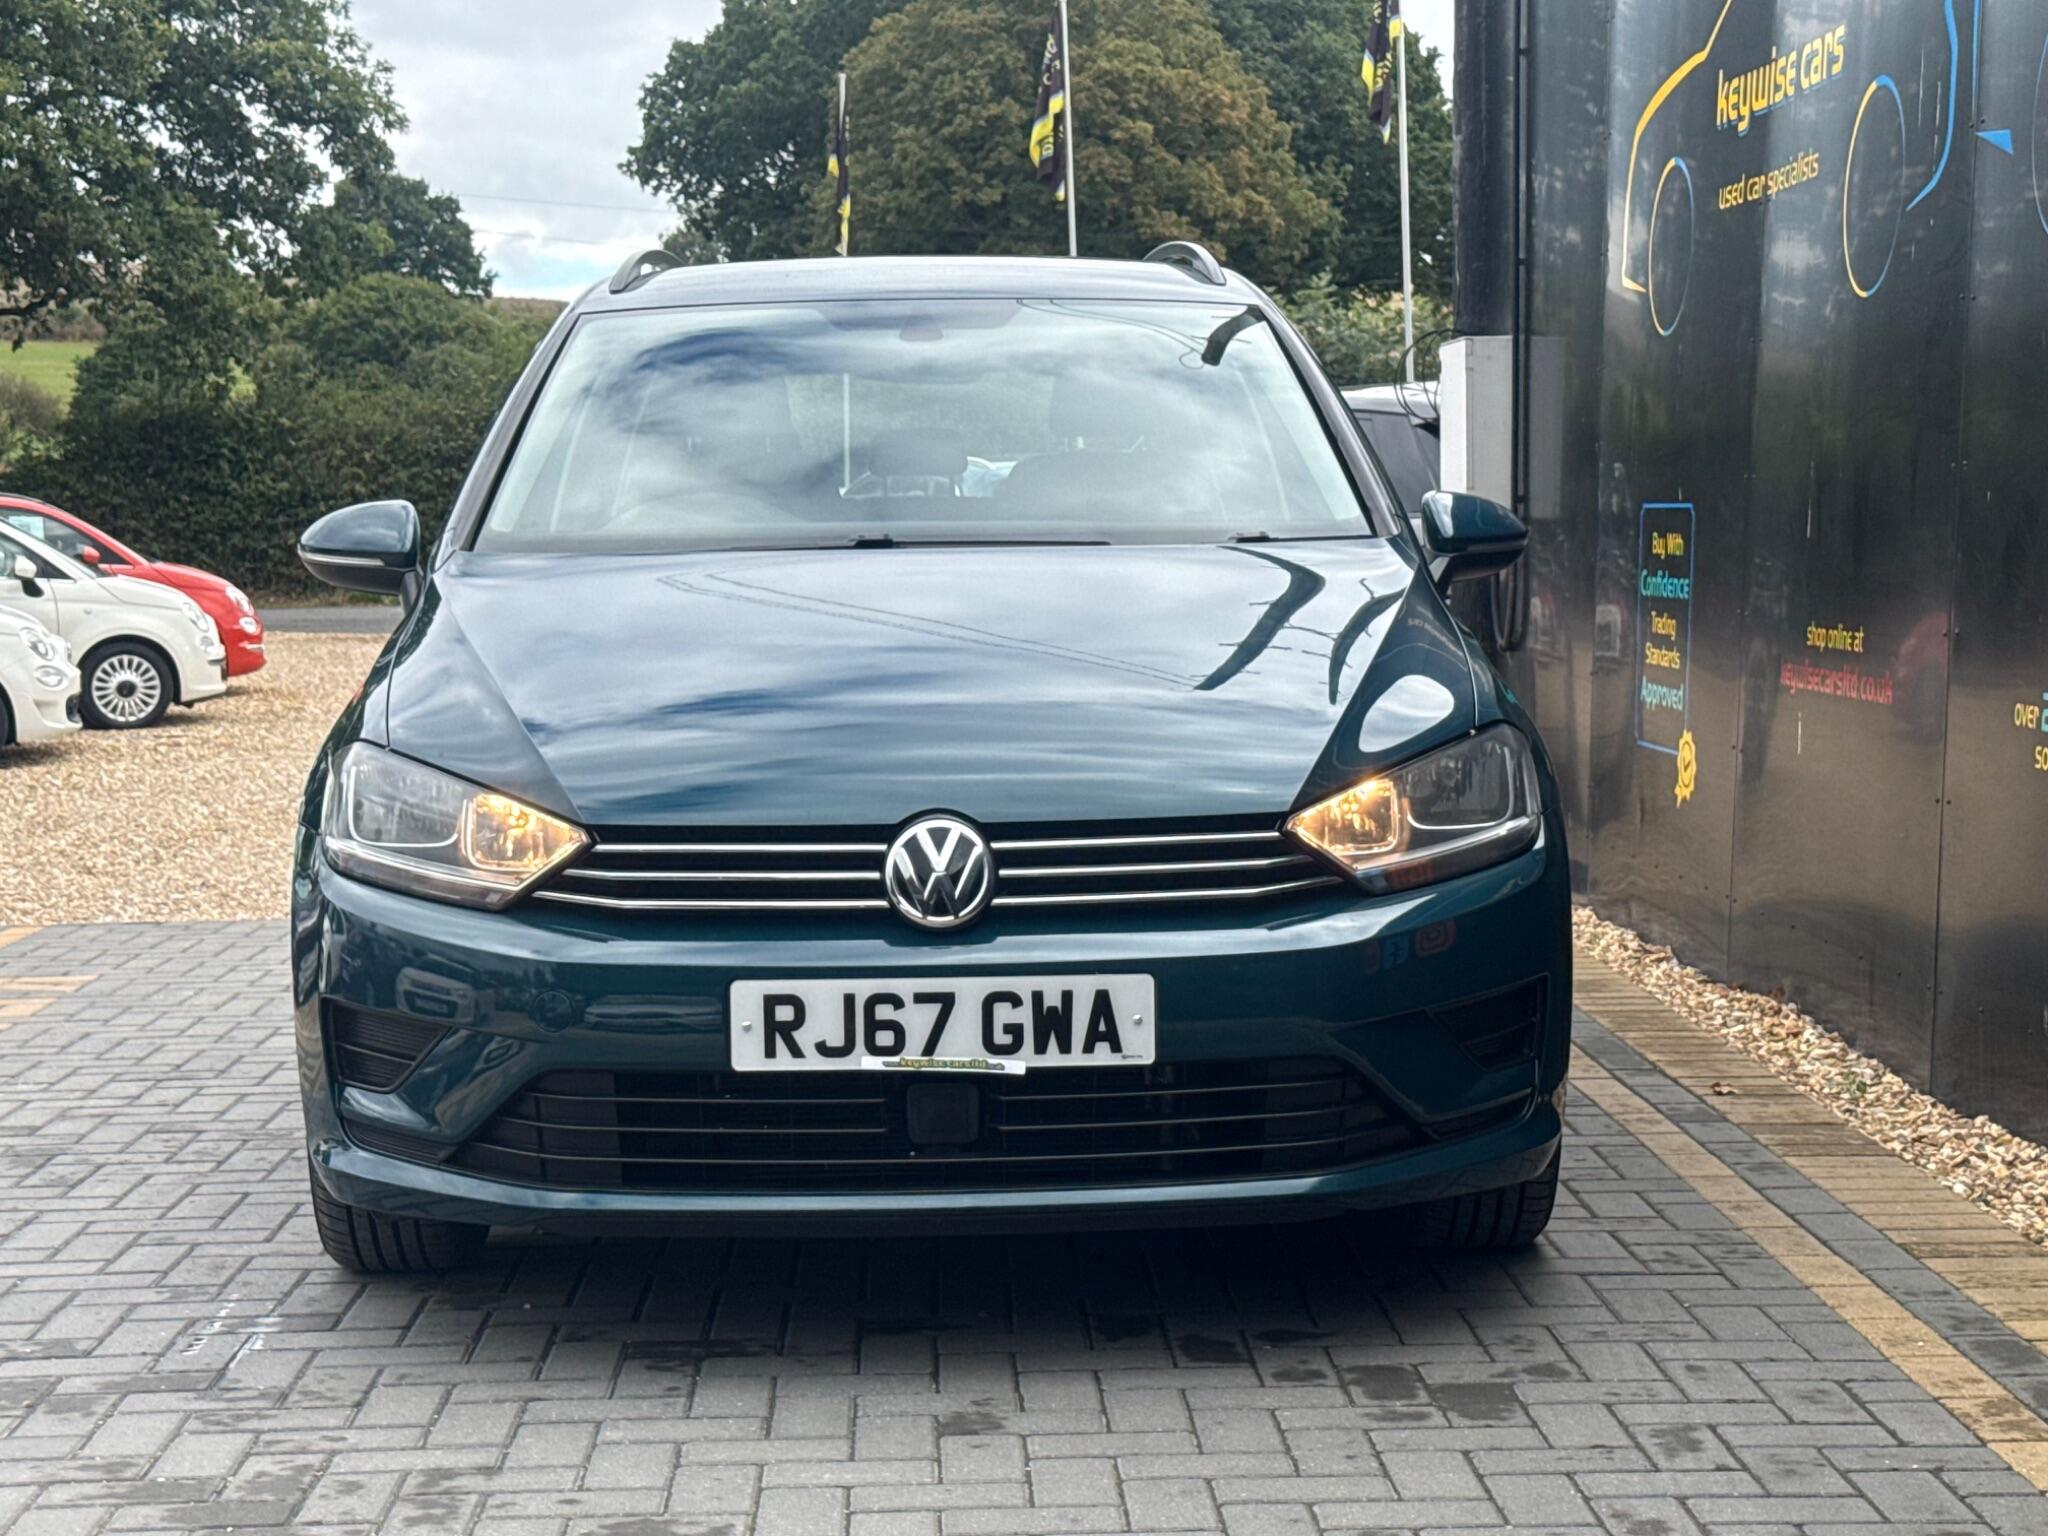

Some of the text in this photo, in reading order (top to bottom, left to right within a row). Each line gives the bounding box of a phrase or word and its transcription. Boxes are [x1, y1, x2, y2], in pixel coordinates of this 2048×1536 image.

[1716, 24, 1846, 134] keywise cars
[1718, 147, 1819, 210] used car specialists
[1652, 531, 1684, 559] Buy With
[1640, 568, 1690, 599] Confidence
[1651, 611, 1677, 640] Trading
[1806, 621, 1864, 653] shop online at
[1645, 641, 1680, 670] Standards
[1640, 676, 1684, 710] Approved
[763, 989, 1123, 1059] RJ67 GWA
